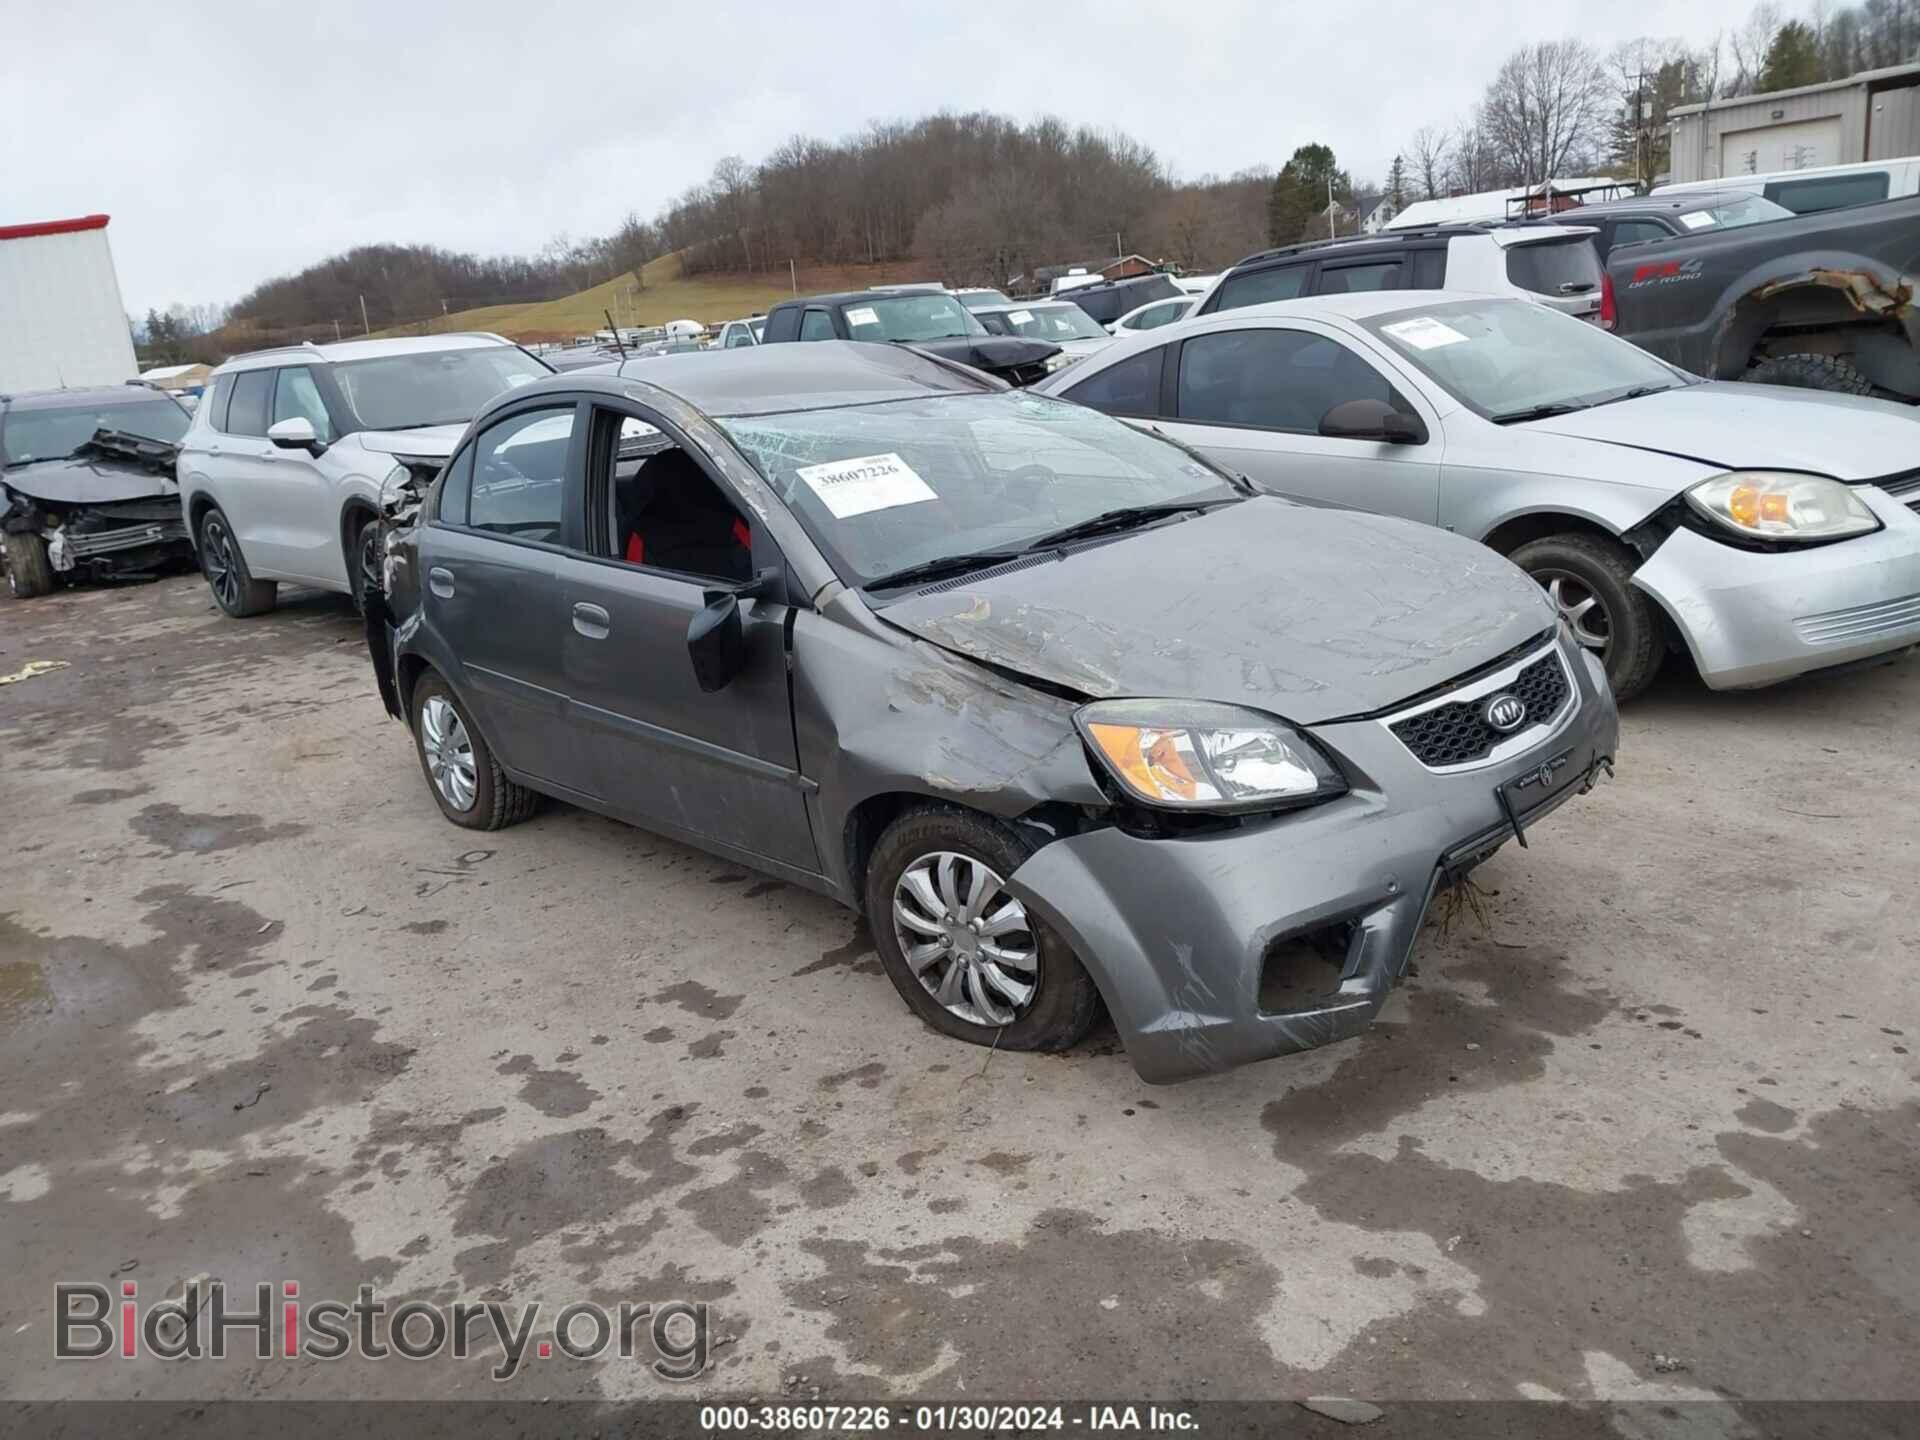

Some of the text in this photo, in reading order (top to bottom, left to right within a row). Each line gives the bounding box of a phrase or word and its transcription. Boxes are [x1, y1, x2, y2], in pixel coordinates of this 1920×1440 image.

[1628, 272, 1702, 289] OFF ROAD
[818, 465, 899, 486] 38607226
[1494, 700, 1520, 724] KIA
